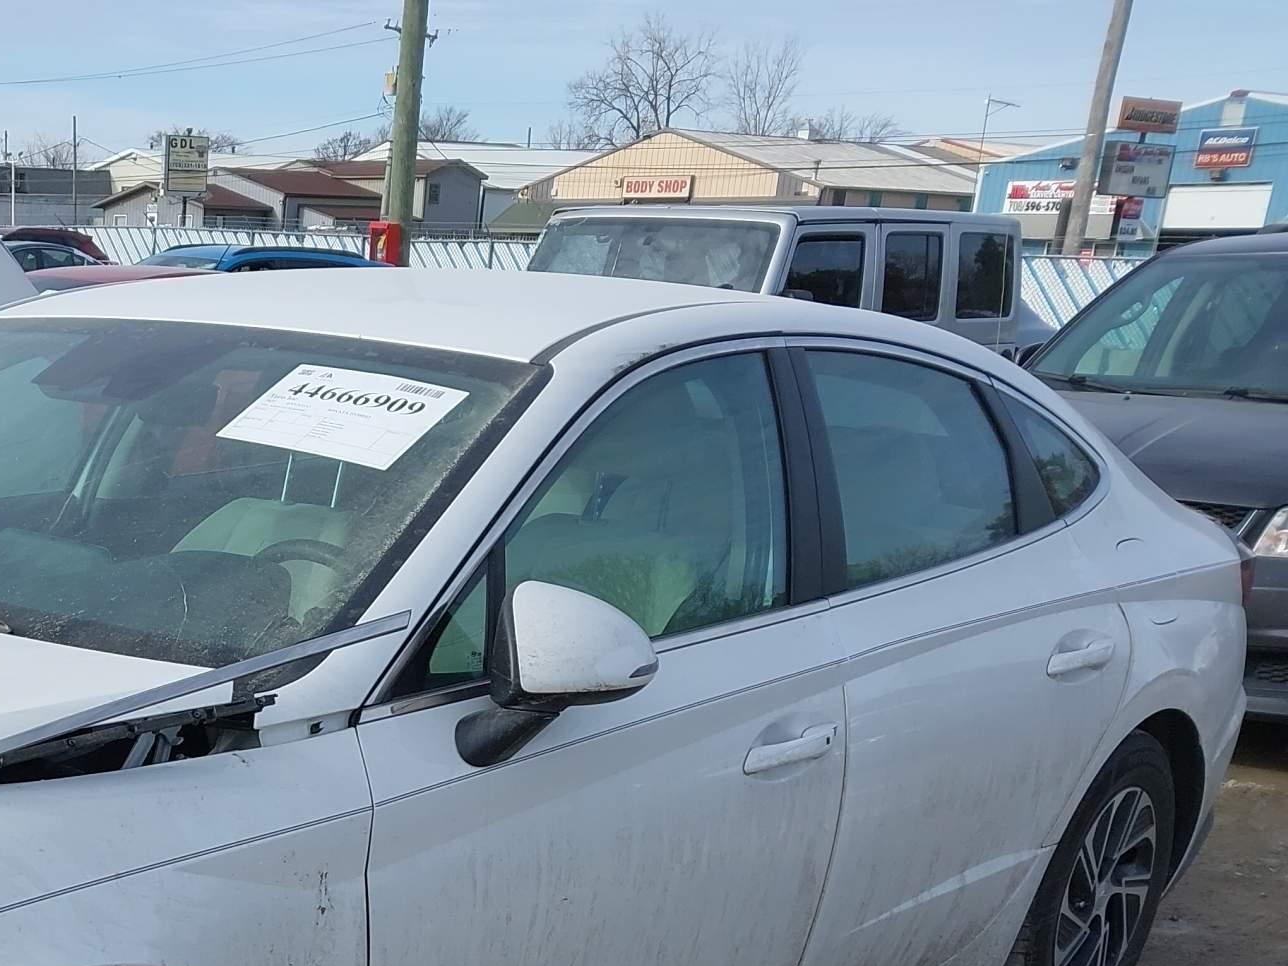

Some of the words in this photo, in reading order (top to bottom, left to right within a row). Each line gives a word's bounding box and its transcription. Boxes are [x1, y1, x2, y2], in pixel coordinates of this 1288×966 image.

[170, 138, 194, 149] GDL
[1204, 135, 1250, 145] ACDelco
[1219, 152, 1247, 163] AUTO
[625, 180, 655, 194] BODY
[657, 180, 688, 194] SHOP
[1008, 200, 1062, 213] 708/596-570
[287, 382, 427, 416] 44666909
